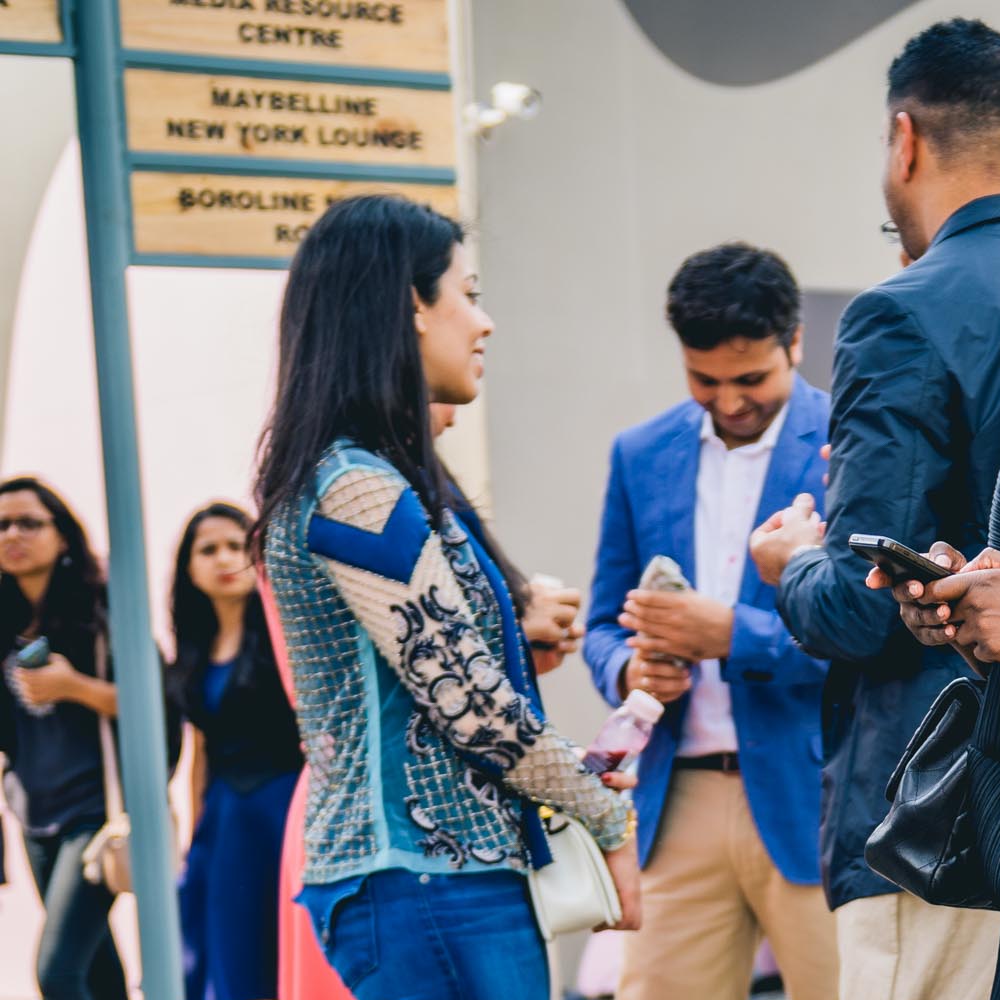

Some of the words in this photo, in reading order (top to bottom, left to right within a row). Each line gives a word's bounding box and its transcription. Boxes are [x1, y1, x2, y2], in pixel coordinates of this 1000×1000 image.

[264, 0, 403, 24] RESOURCE
[238, 22, 342, 49] CENTRE
[210, 87, 378, 117] MAYBELLINE
[166, 119, 226, 140] NEW
[237, 121, 306, 145] YORK
[317, 127, 424, 150] LOUNGE
[178, 187, 316, 212] BOROLINE
